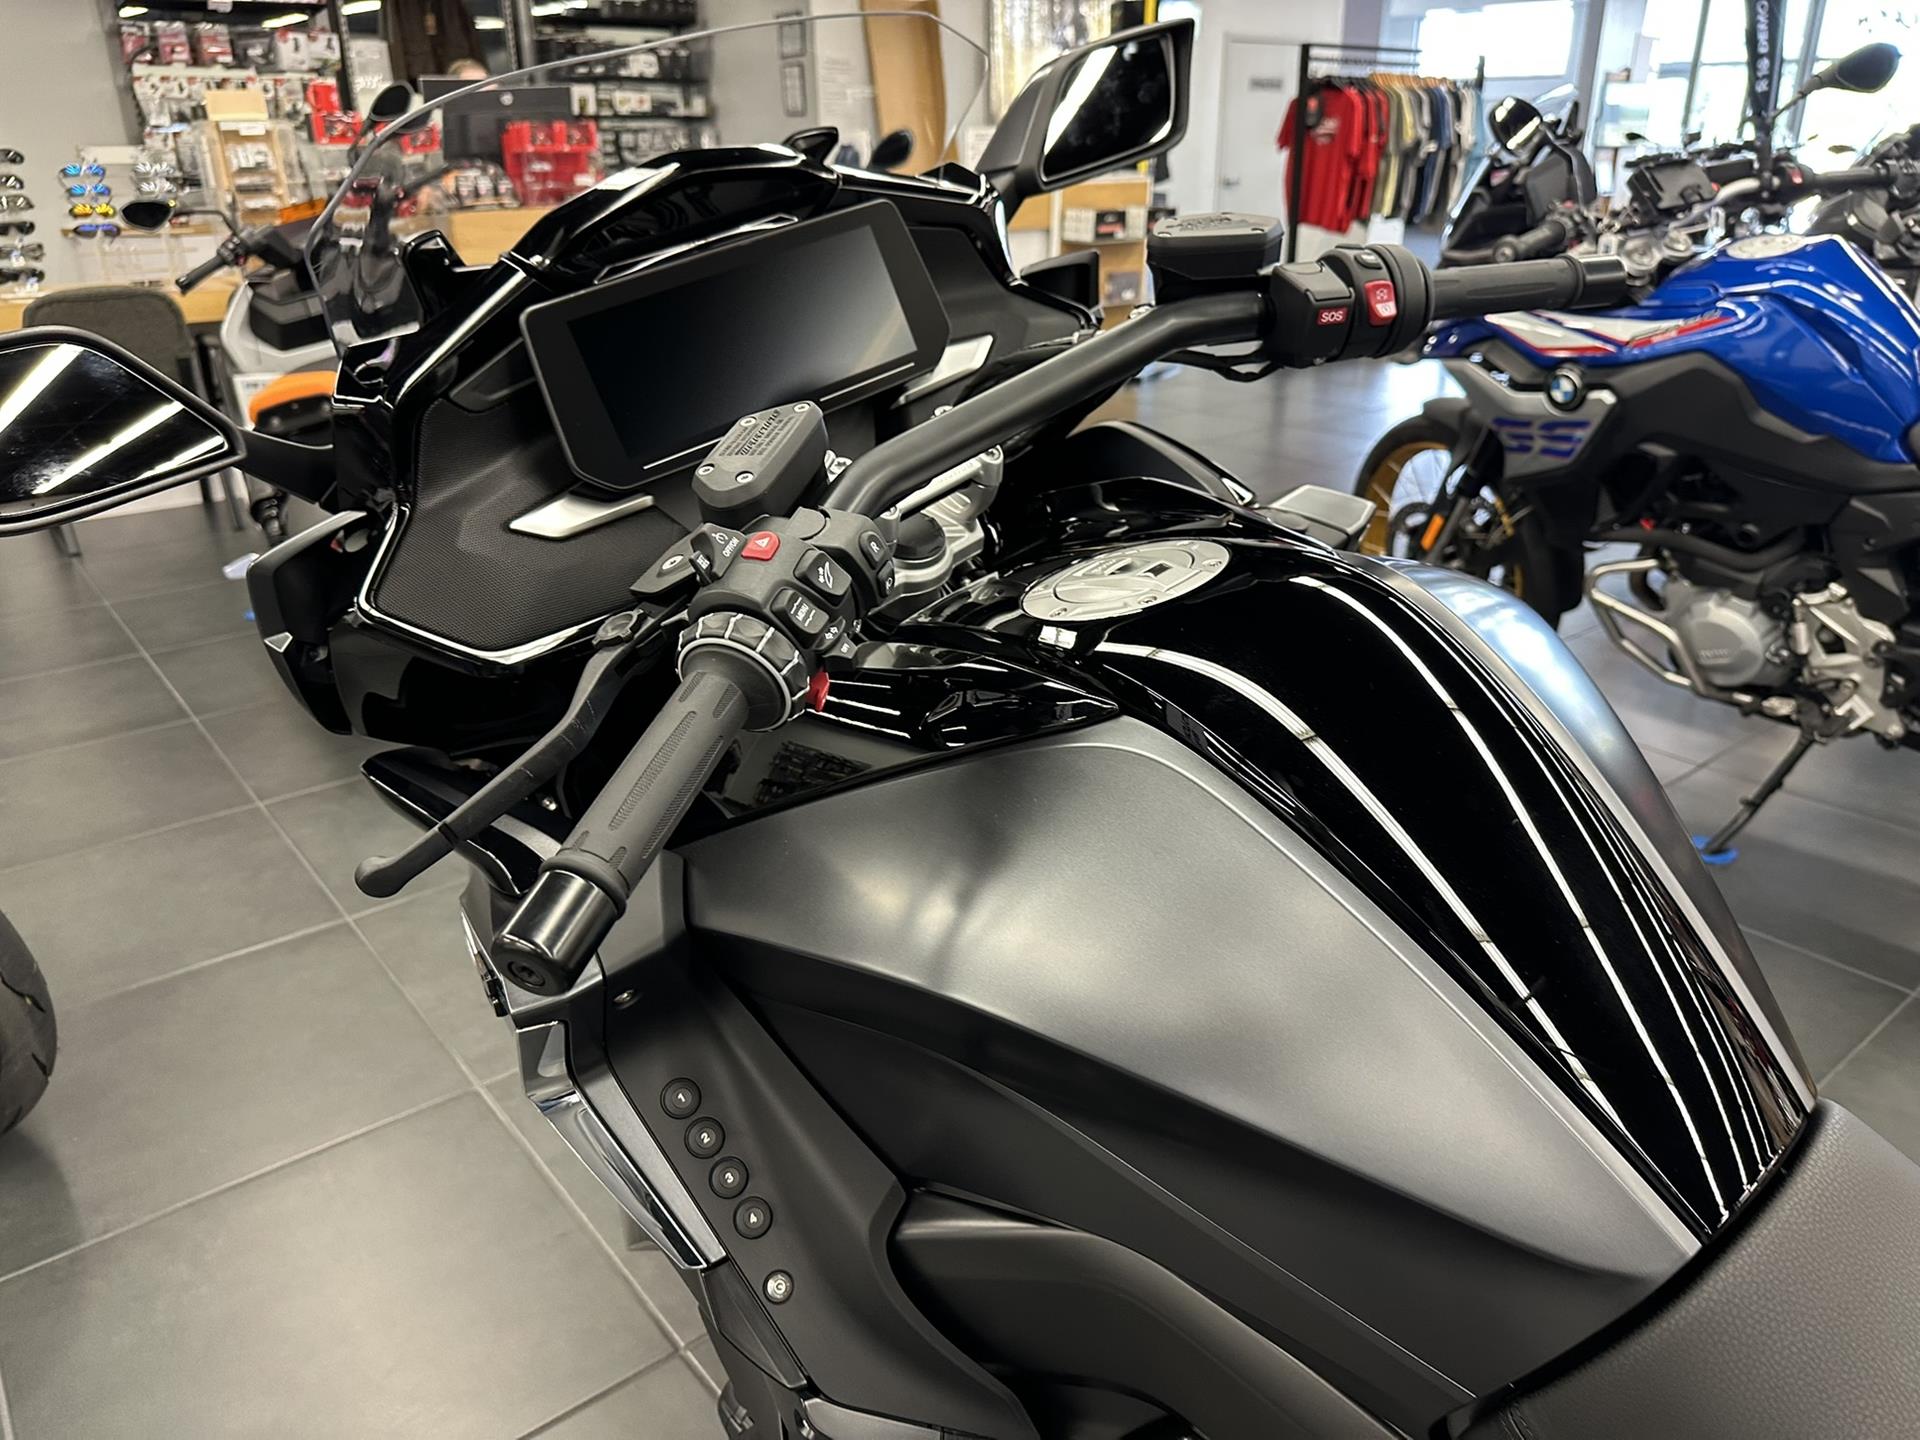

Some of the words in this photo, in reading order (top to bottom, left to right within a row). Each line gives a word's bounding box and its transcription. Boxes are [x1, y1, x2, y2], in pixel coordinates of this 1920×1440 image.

[1757, 0, 1769, 54] DEMO
[1320, 311, 1344, 322] SOS
[722, 536, 740, 558] OFF/ON
[870, 541, 880, 553] R
[796, 604, 809, 621] MENU
[677, 1093, 686, 1102] 1
[700, 1132, 710, 1144] 2
[725, 1173, 734, 1184] 3
[750, 1212, 758, 1224] 4
